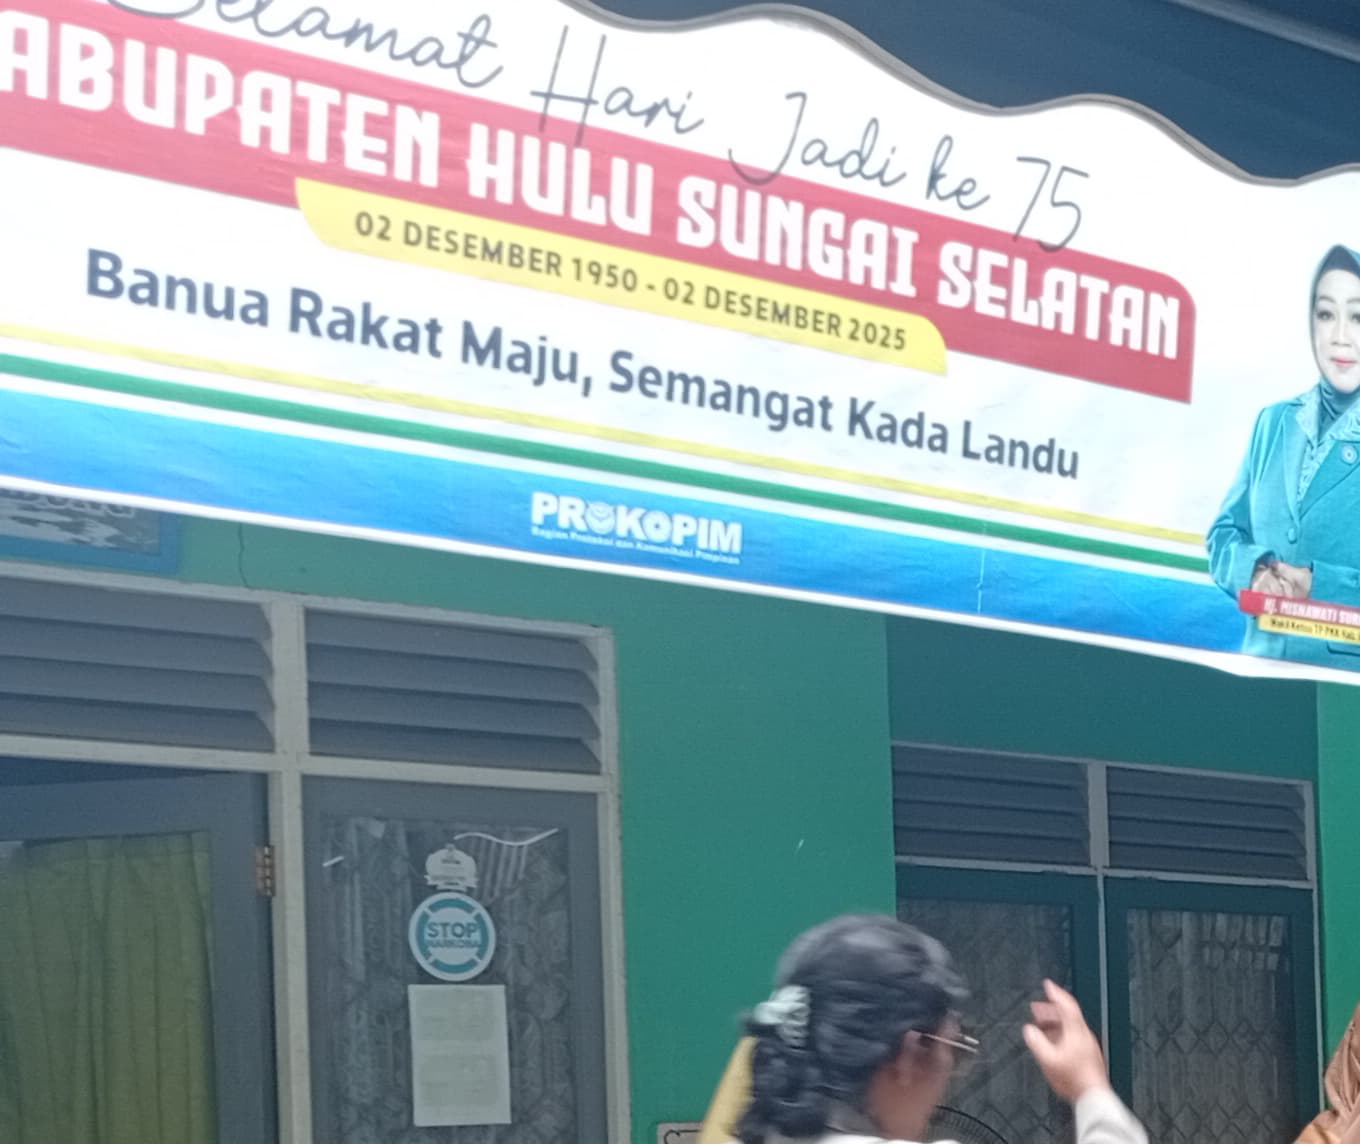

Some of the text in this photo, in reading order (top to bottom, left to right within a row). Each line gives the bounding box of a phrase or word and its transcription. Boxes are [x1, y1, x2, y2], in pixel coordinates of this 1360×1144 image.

[530, 25, 705, 147] Hari
[728, 92, 907, 185] Jadi
[925, 135, 991, 211] ke
[1011, 155, 1091, 253] 75
[355, 210, 393, 243] 02
[403, 220, 563, 277] DESEMBER
[571, 256, 638, 293] 1950
[663, 277, 696, 306] 02
[703, 285, 842, 338] DESEMBER
[847, 318, 907, 352] 2025
[466, 122, 655, 236] HULU
[676, 174, 920, 298] SUNGAI
[936, 240, 1181, 361] SELATAN
[86, 247, 1080, 479] Banua Rakat Maju, Semangat Kada Landu
[530, 491, 743, 555] PROKOPIM
[426, 921, 479, 939] STOP
